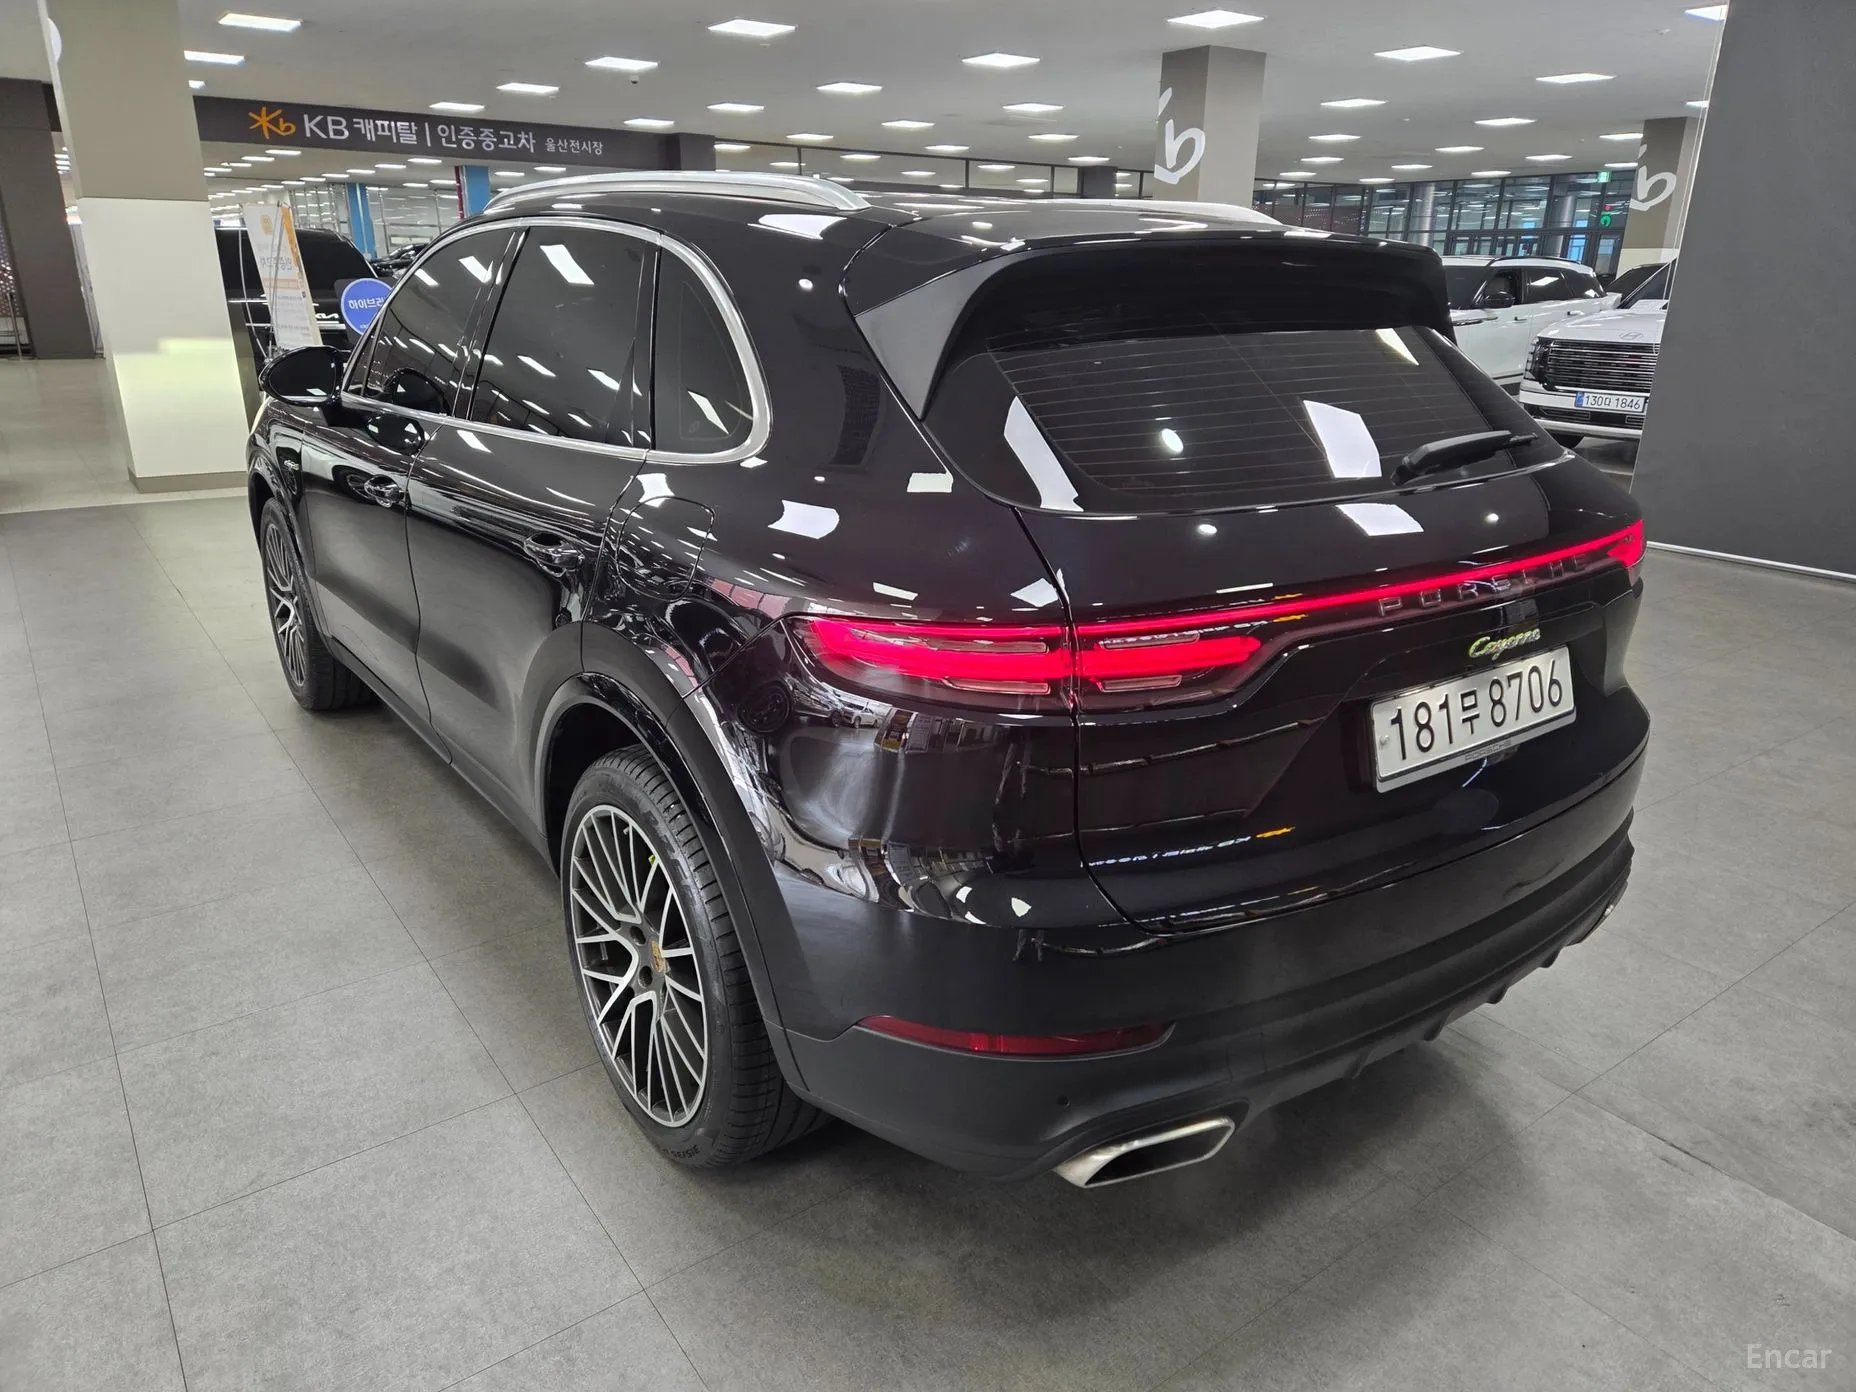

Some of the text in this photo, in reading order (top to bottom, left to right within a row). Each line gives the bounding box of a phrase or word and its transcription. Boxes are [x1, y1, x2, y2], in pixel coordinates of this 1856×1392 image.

[303, 114, 349, 140] KB
[353, 118, 418, 144] 캐피탈
[437, 124, 536, 153] 인증중고차
[544, 137, 603, 156] 울산전시장
[348, 297, 385, 310] 하이브리
[1615, 397, 1640, 409] 1846
[1468, 628, 1541, 661] Cayenne
